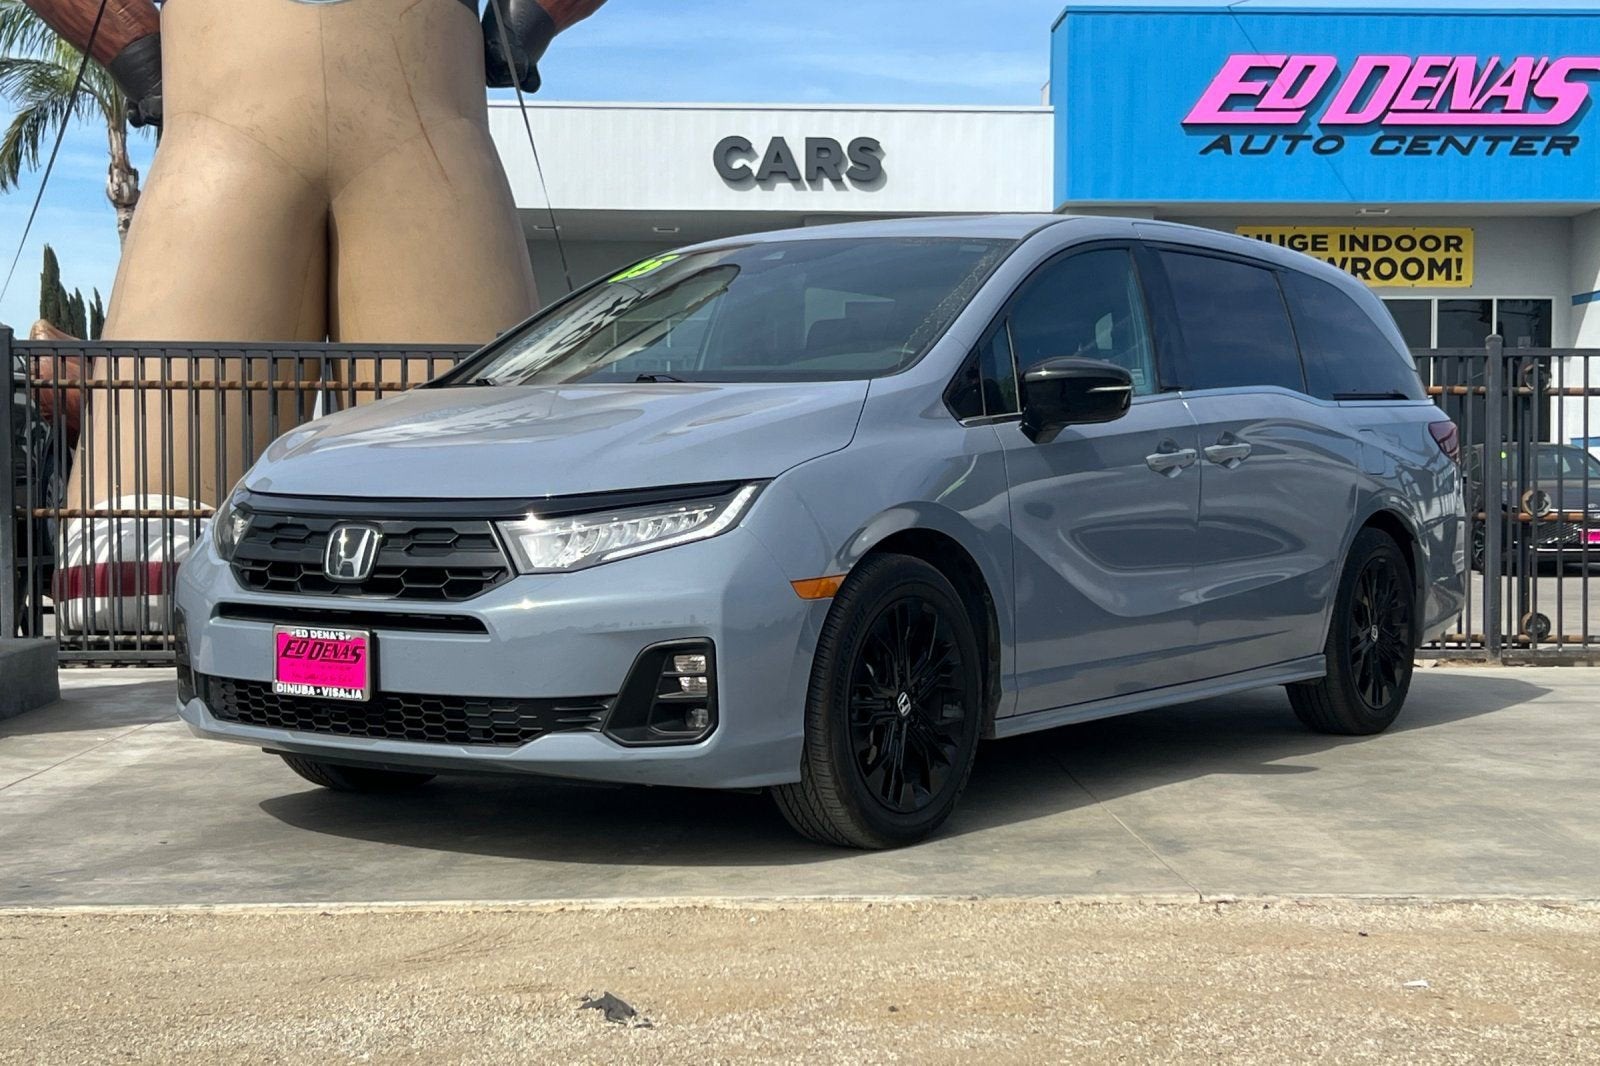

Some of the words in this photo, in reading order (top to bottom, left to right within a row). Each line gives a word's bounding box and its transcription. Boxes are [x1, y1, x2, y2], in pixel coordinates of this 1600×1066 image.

[1181, 54, 1338, 125] ED
[1319, 55, 1600, 126] DENA'S
[1199, 134, 1345, 156] AUTO
[1369, 135, 1580, 157] CENTER
[713, 135, 882, 182] CARS
[1339, 234, 1463, 253] INDOOR
[295, 629, 309, 638] ED
[310, 630, 345, 641] DENA'S
[281, 640, 309, 659] ED
[276, 683, 315, 696] DINUBA
[321, 686, 362, 699] VISALIA
